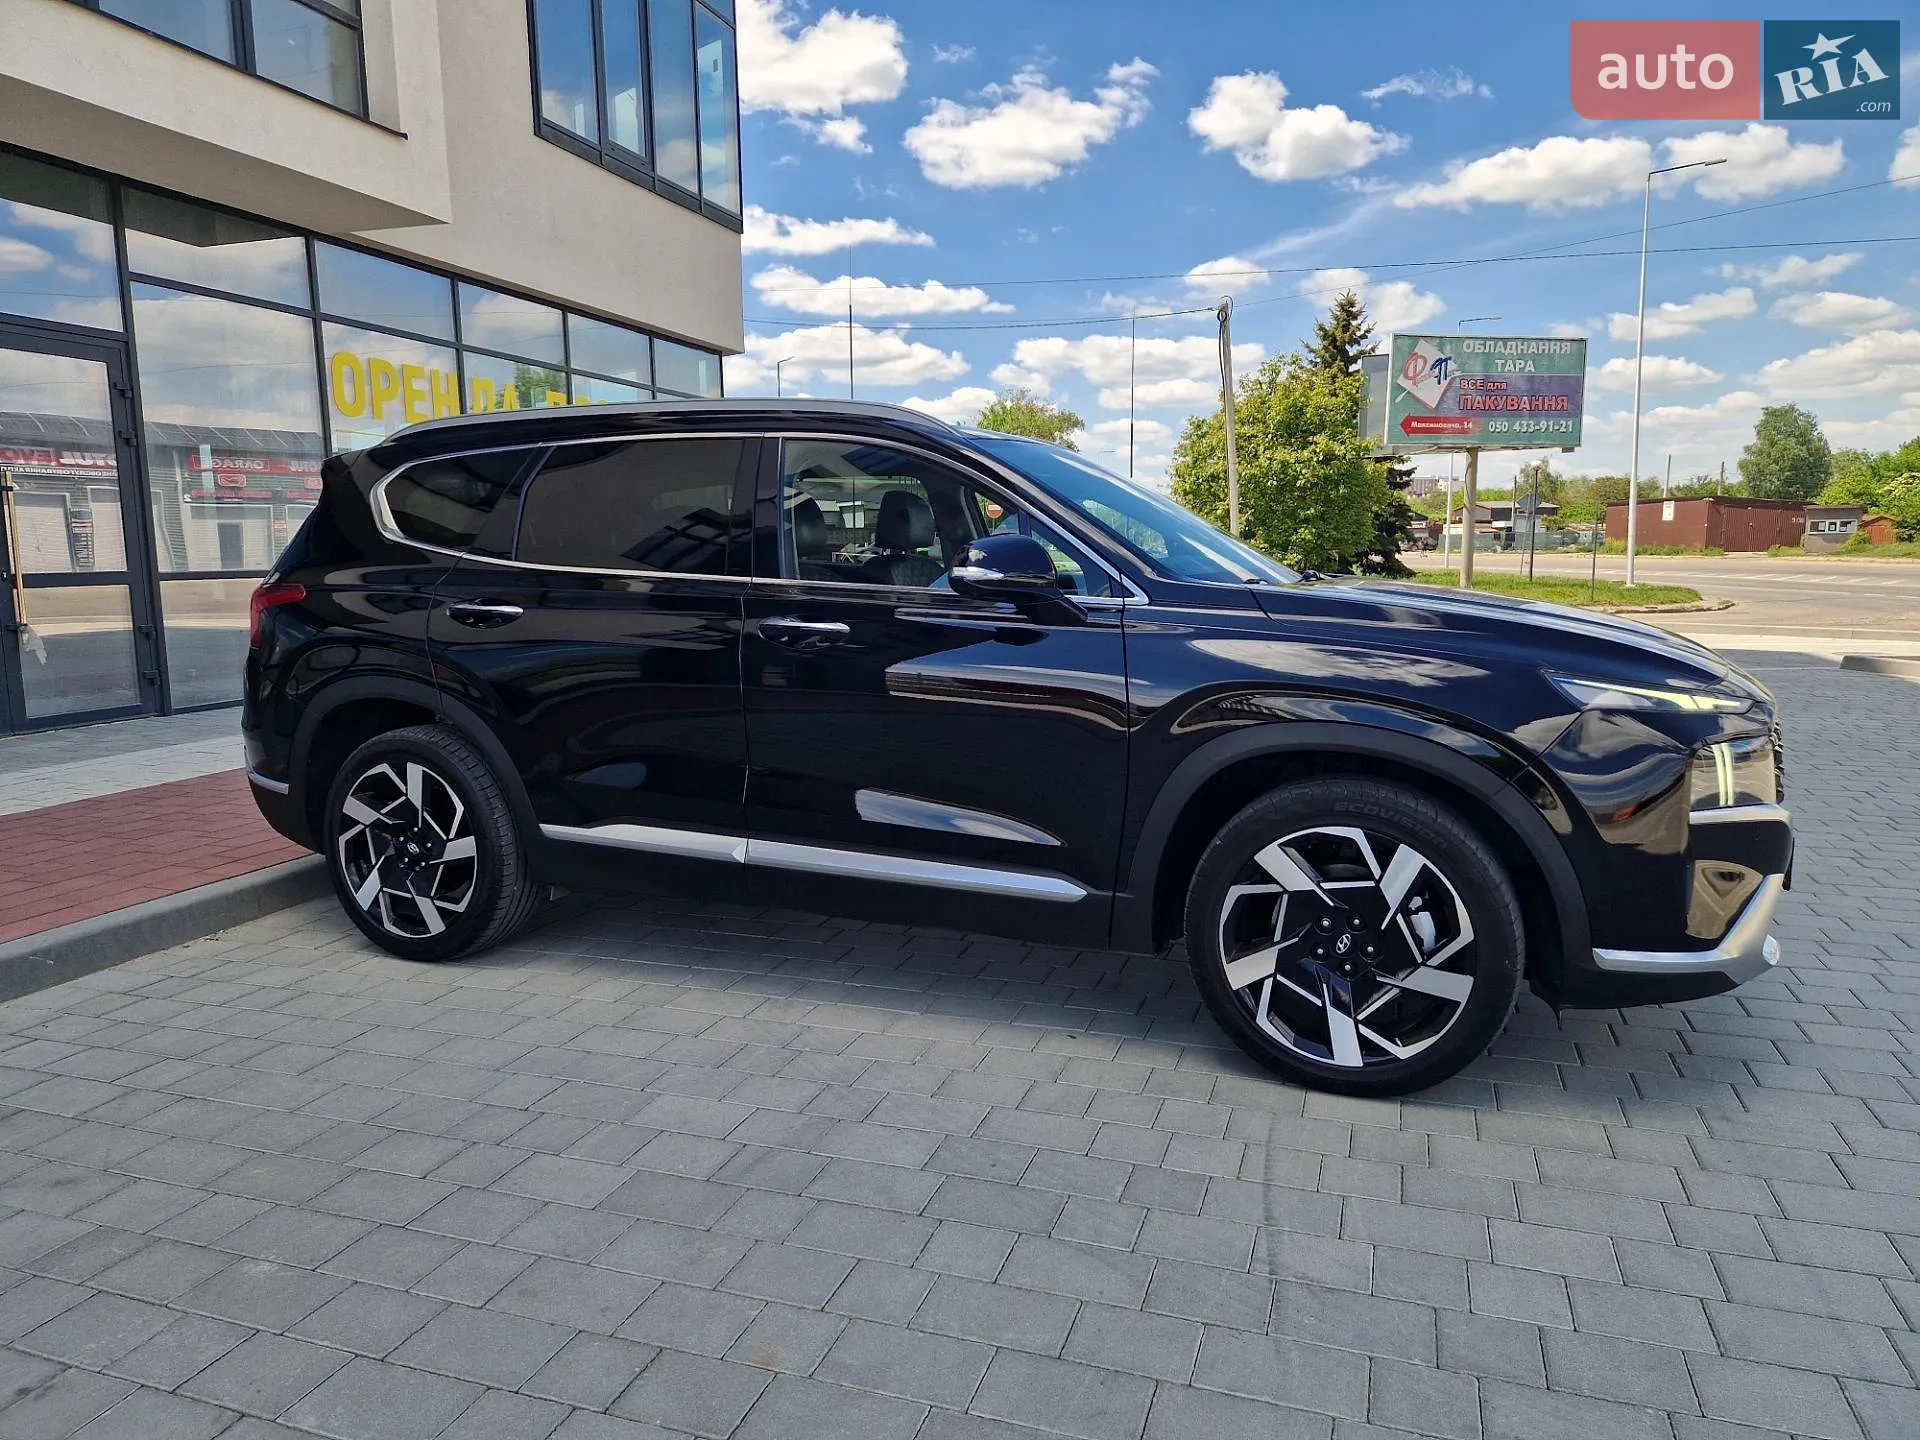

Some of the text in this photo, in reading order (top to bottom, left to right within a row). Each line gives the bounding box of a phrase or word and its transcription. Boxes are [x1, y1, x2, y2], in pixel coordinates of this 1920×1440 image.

[1462, 340, 1571, 356] ОБЛАДНАННЯ
[1495, 359, 1536, 372] ТАРА
[1460, 379, 1508, 392] ВСЕ для
[1459, 395, 1569, 411] ПАКУВАННЯ
[1488, 421, 1573, 434] 050 433-91-21
